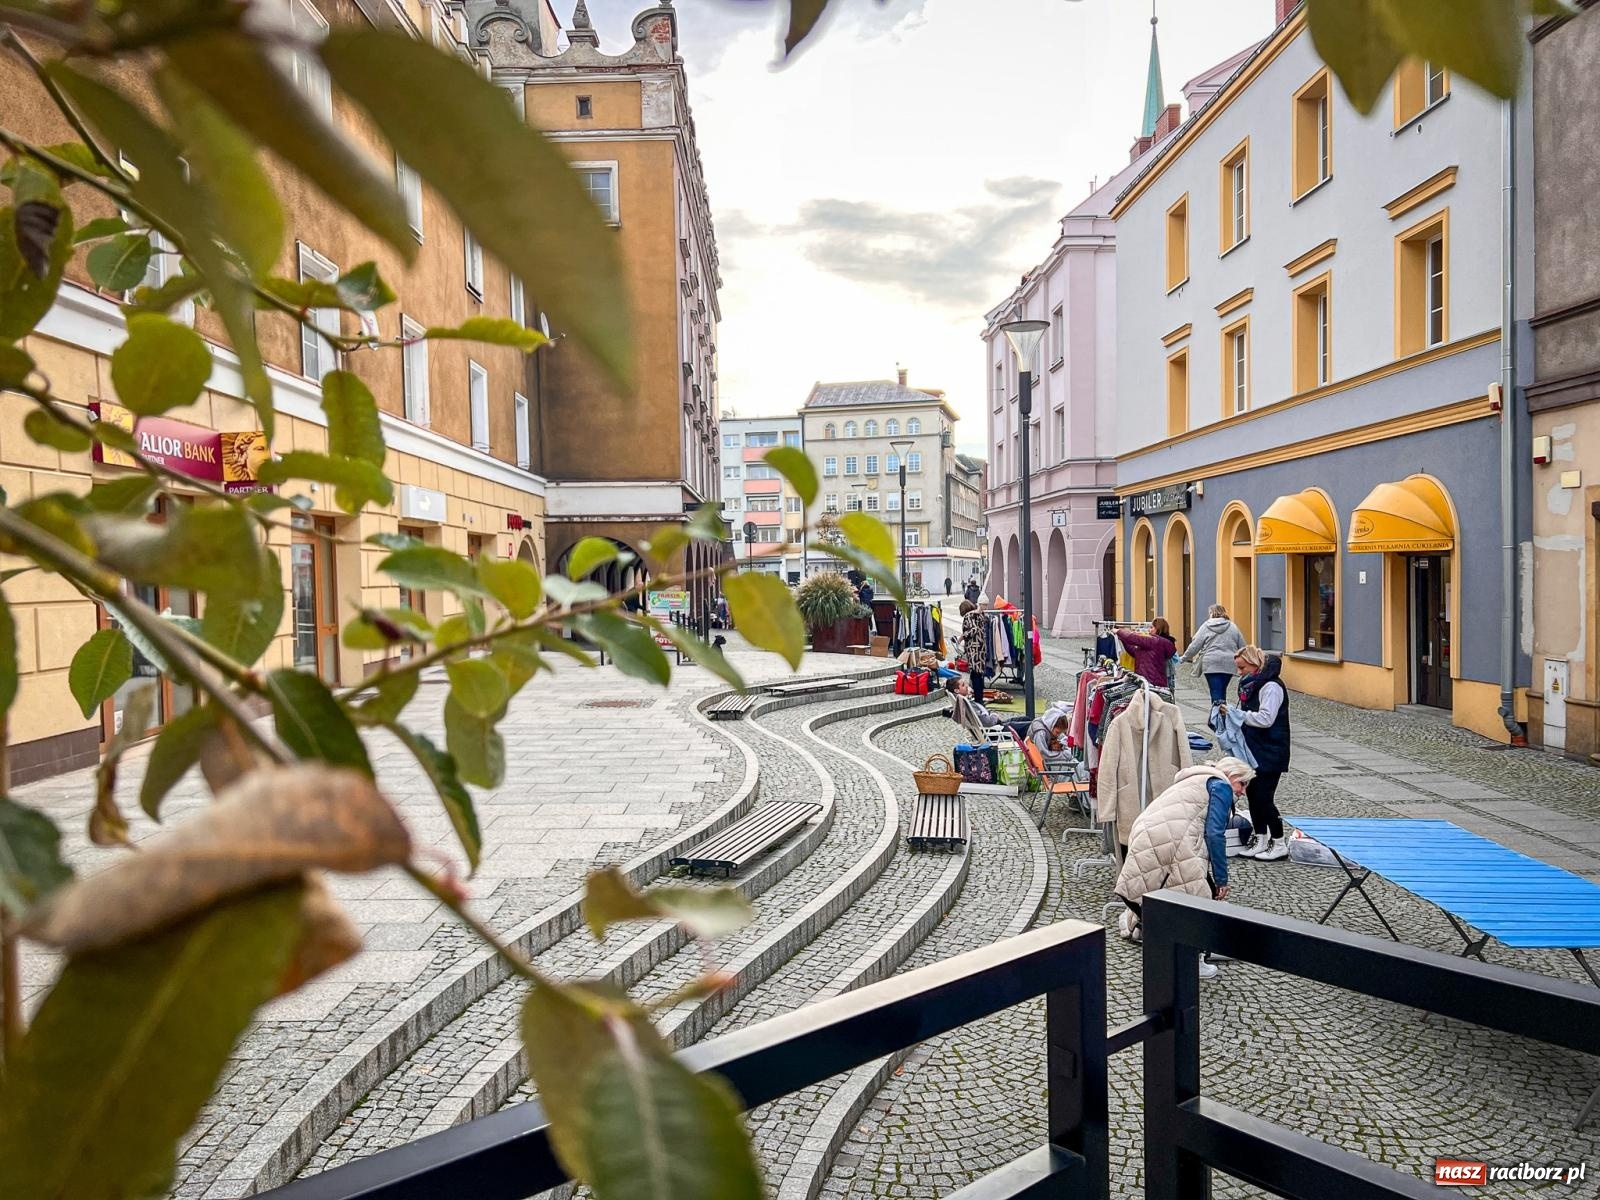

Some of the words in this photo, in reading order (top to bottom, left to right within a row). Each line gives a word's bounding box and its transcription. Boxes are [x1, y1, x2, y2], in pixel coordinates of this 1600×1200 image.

[140, 431, 183, 458] ALIOR
[184, 441, 216, 464] BANK
[228, 486, 269, 494] PARTER
[1132, 493, 1162, 512] JUBILER
[1411, 541, 1449, 550] CUKIERNIA
